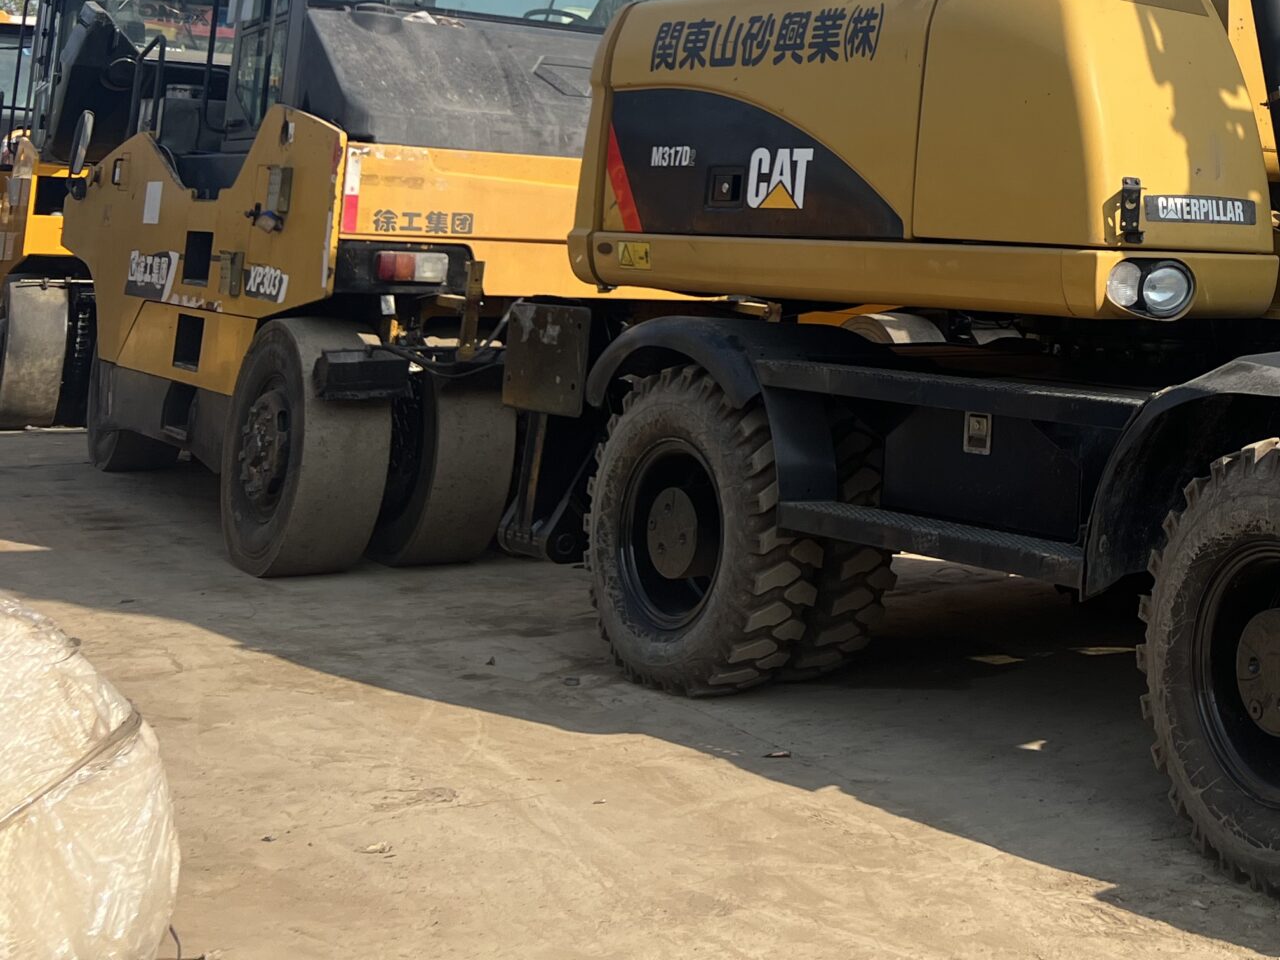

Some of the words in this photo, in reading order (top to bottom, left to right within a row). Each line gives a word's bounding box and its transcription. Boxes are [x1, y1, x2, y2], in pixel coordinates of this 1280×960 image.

[747, 147, 814, 209] CAT
[373, 208, 474, 235] 徐工集团
[1158, 196, 1244, 222] CATERPILLAR
[246, 265, 280, 296] XP303
